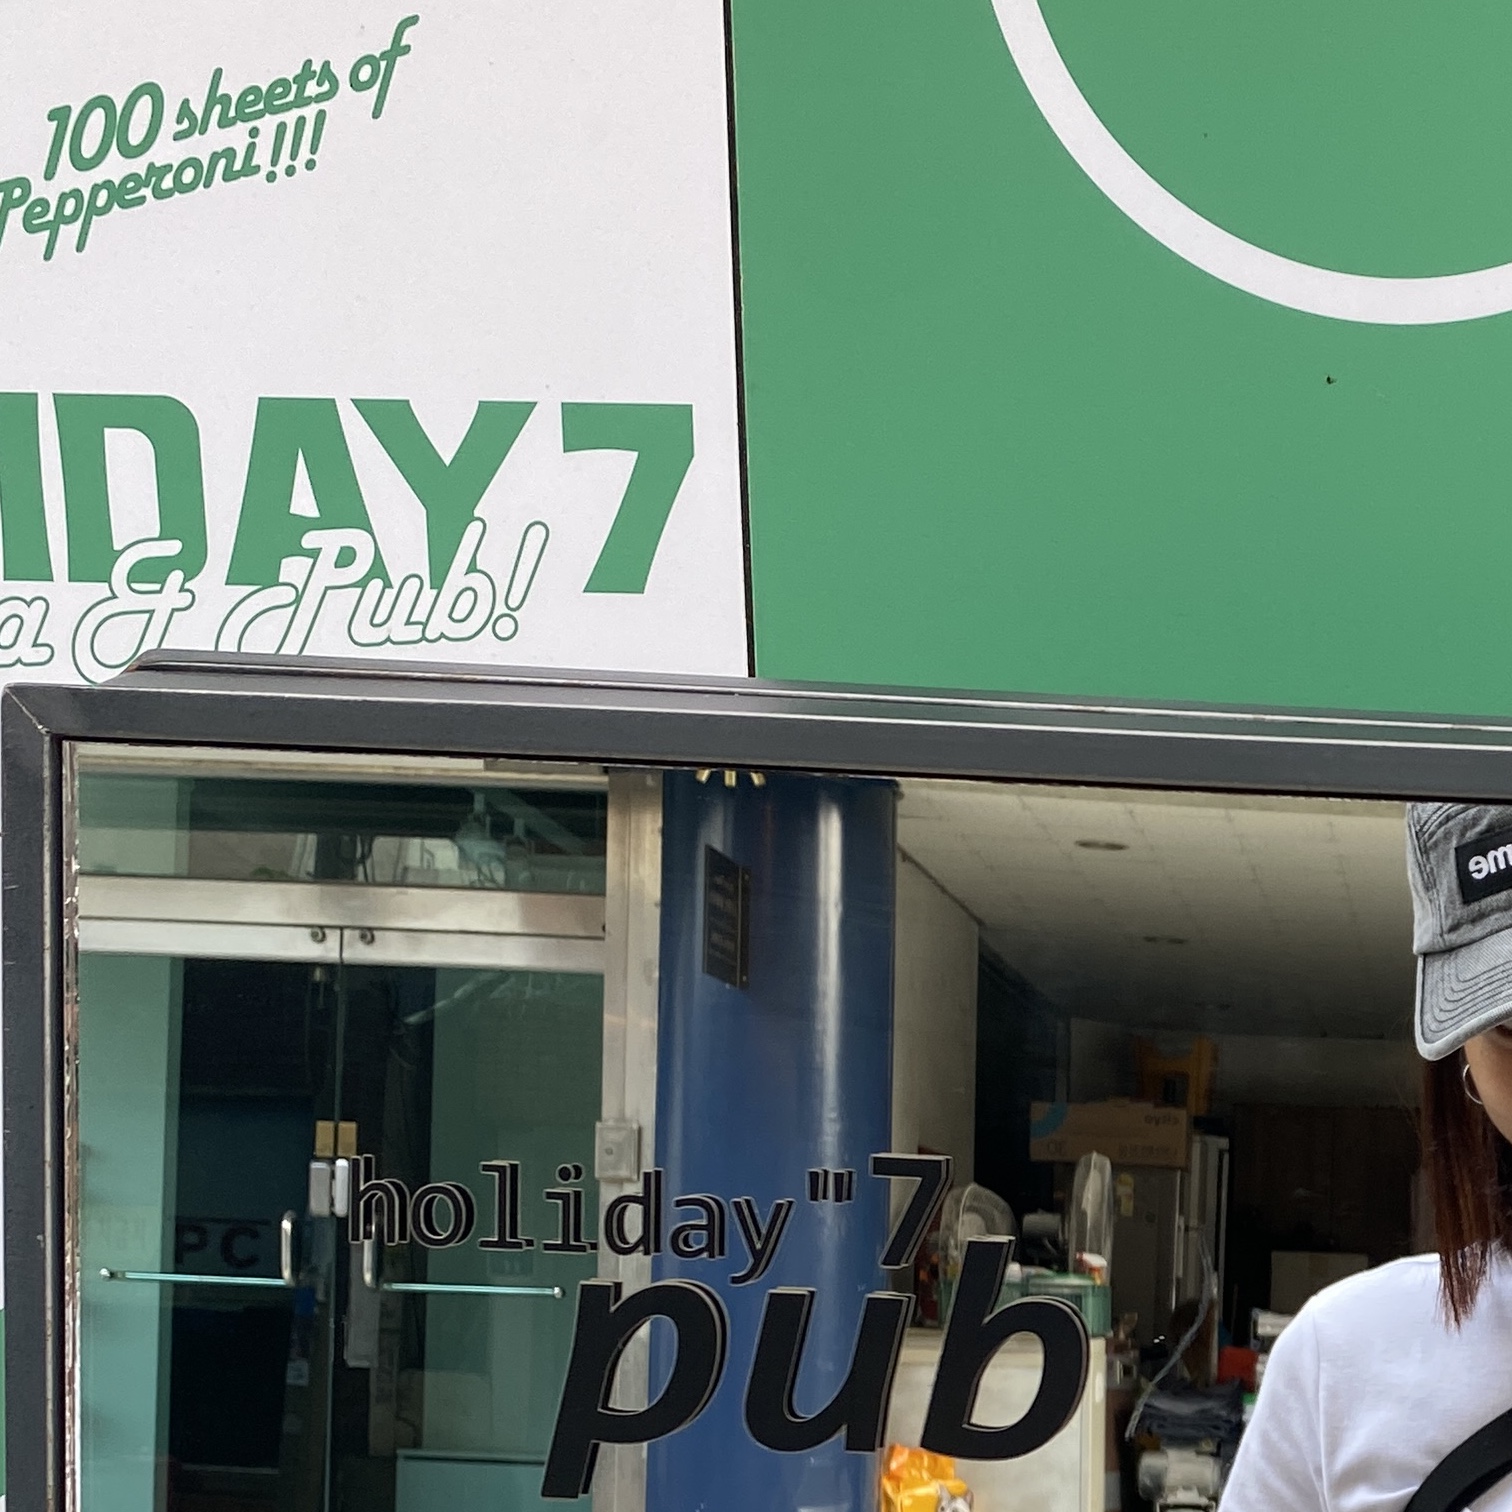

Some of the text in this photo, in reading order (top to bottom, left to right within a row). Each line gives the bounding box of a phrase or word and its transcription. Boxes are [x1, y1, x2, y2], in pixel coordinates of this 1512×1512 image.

[44, 15, 419, 181] 100 sheets of
[0, 109, 326, 261] Pepperoni!!!
[72, 536, 196, 687] &
[214, 516, 549, 657] Pub!
[541, 1235, 1090, 1498] pub
